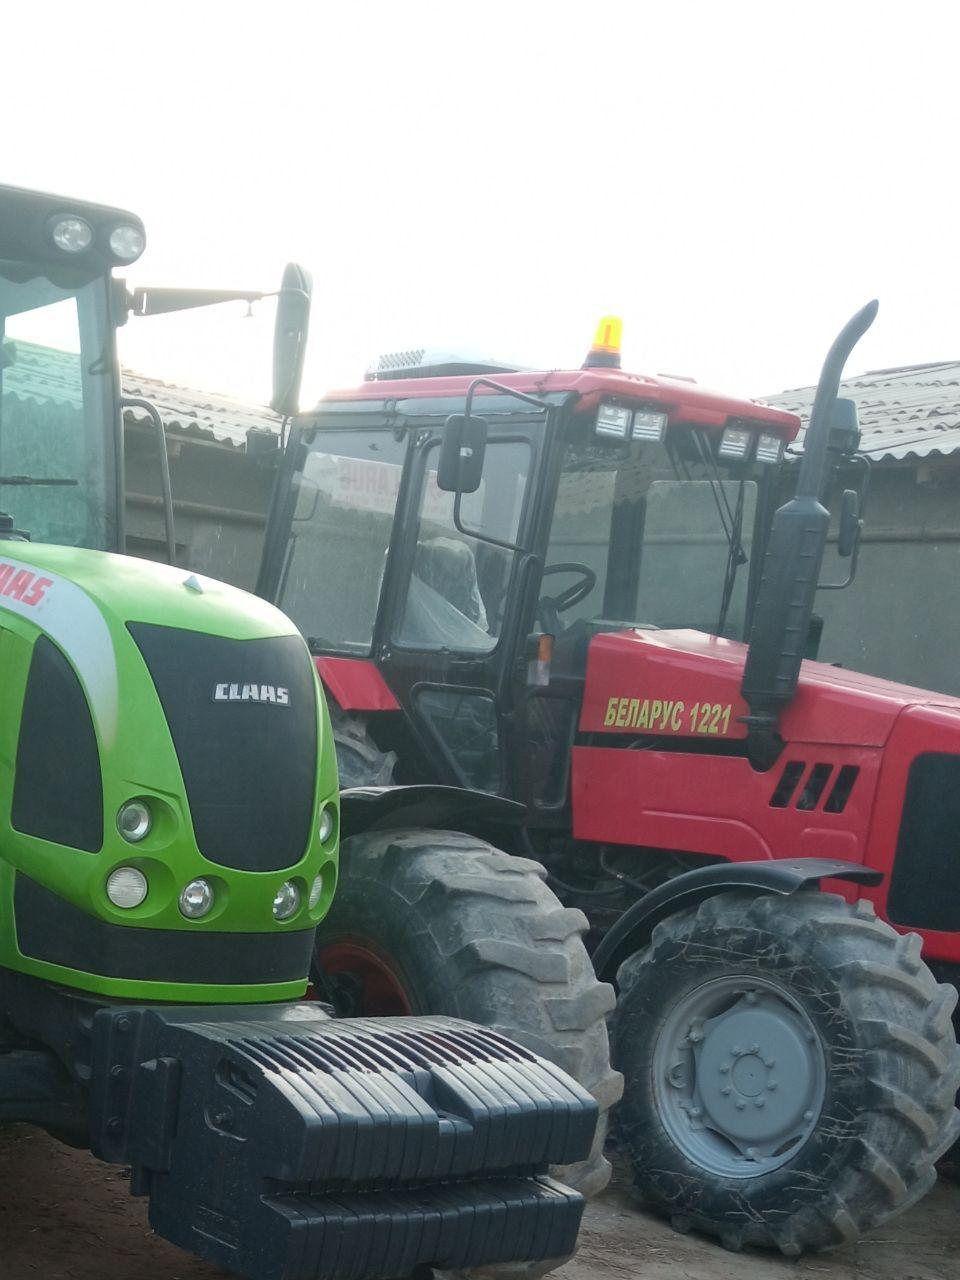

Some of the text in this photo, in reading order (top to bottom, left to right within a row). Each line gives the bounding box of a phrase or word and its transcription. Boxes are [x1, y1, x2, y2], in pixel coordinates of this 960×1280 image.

[214, 682, 290, 705] CLAAS
[603, 697, 732, 734] БЕЛАРУС 1221
